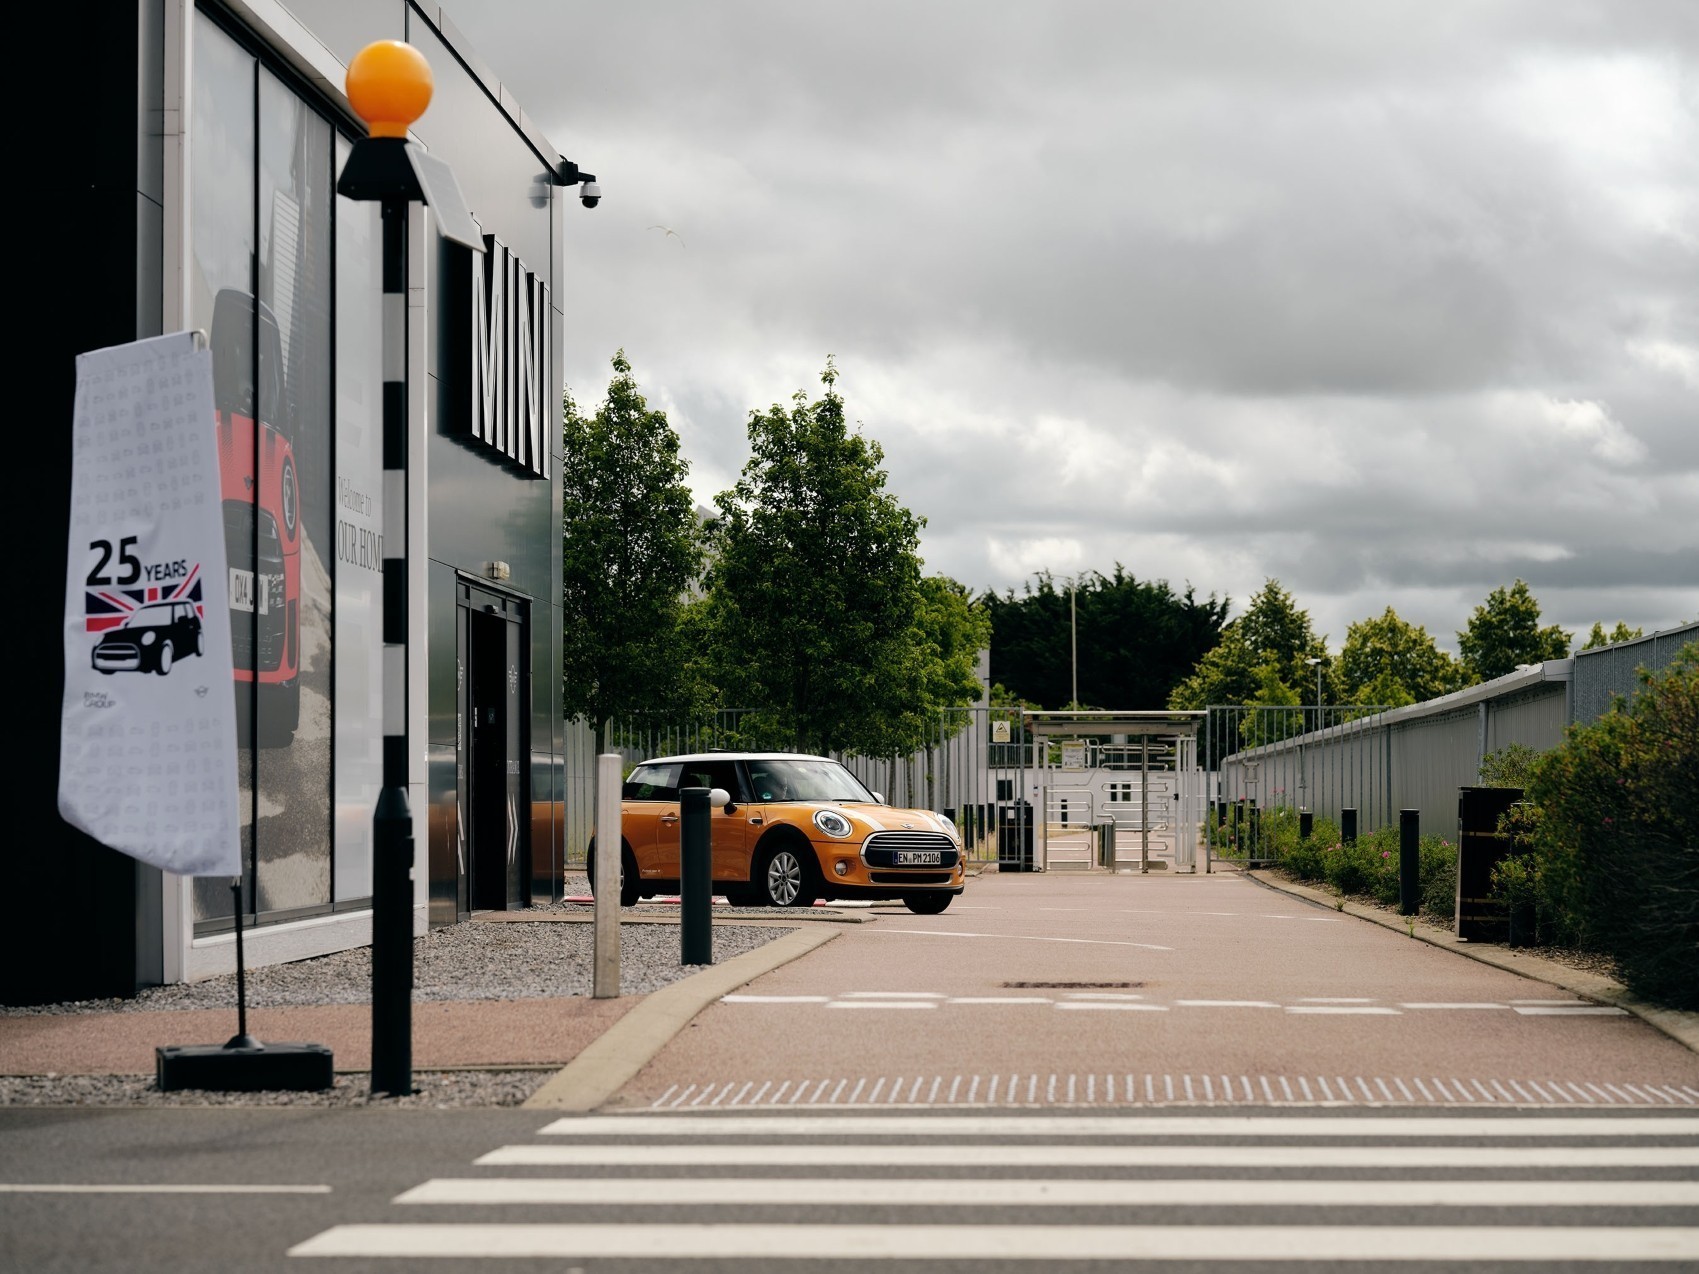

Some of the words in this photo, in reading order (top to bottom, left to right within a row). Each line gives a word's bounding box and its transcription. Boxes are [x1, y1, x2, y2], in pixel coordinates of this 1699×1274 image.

[471, 212, 549, 480] MINI
[338, 476, 365, 515] Welcome
[365, 494, 372, 518] to
[86, 535, 142, 586] 25
[144, 559, 188, 581] YEARS
[338, 519, 358, 566] OUR
[898, 853, 908, 863] EN
